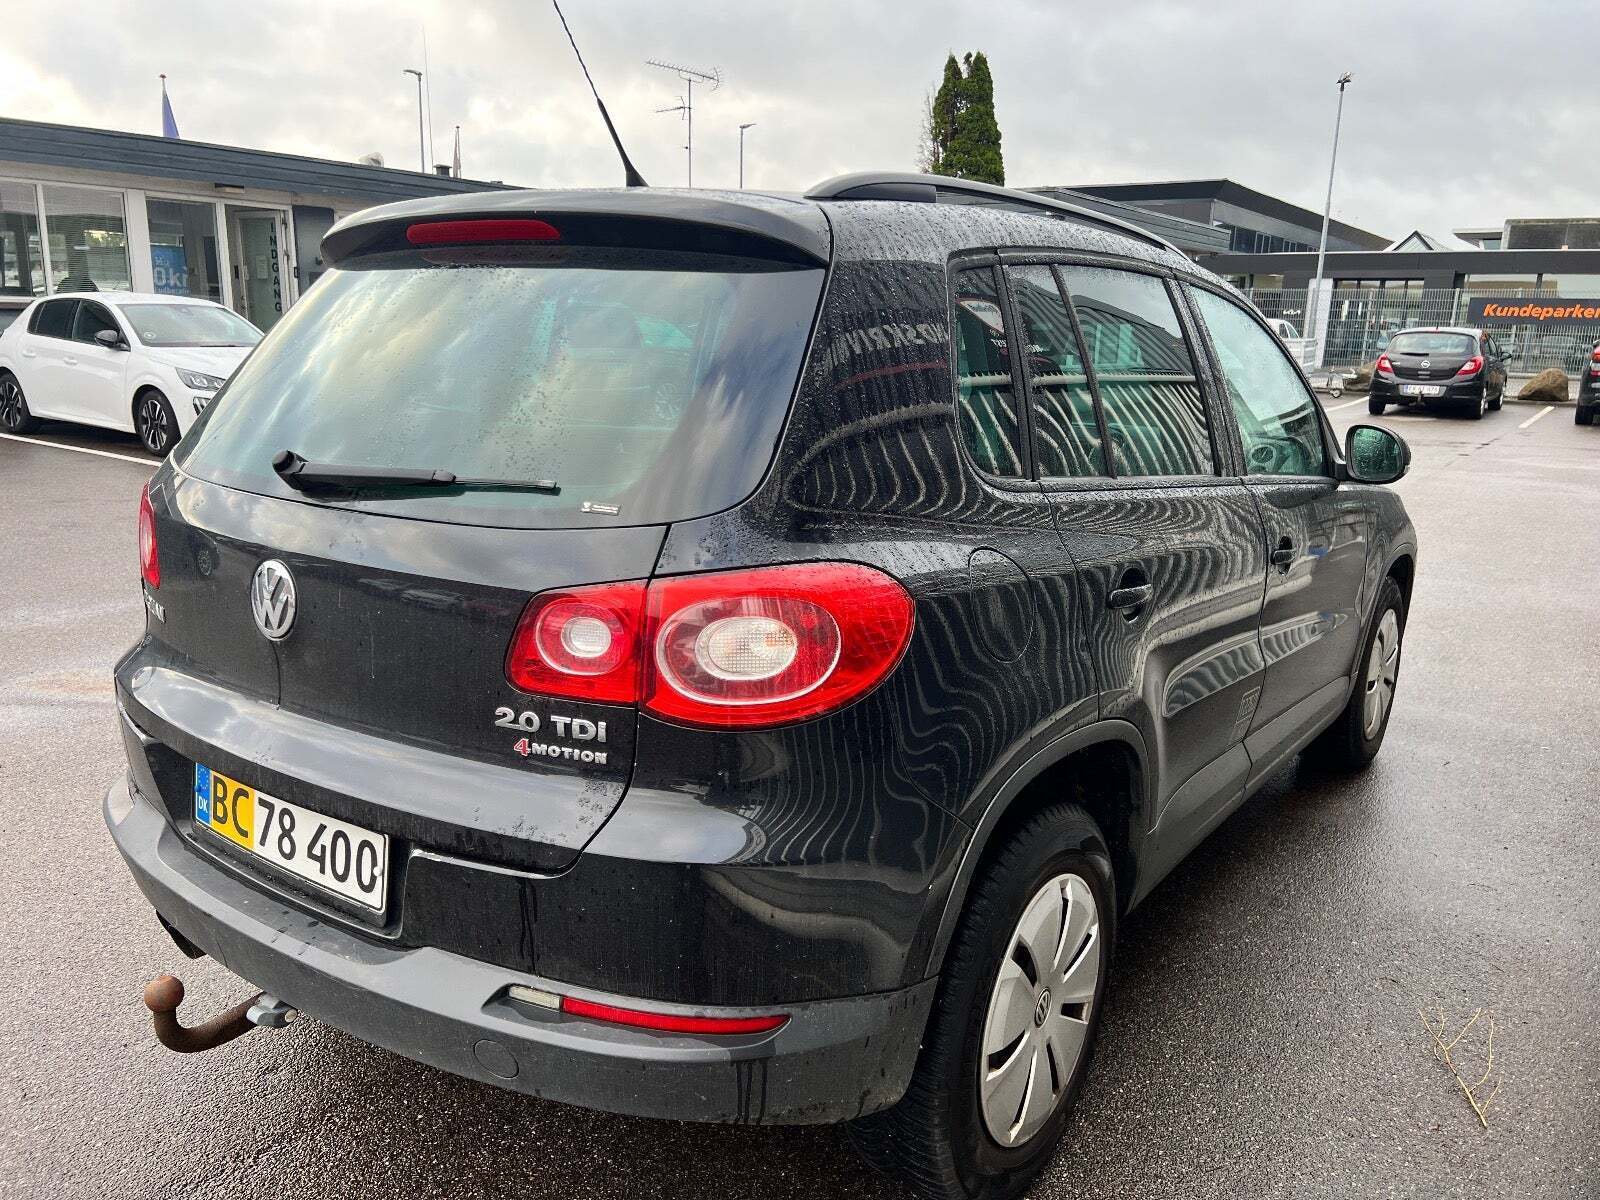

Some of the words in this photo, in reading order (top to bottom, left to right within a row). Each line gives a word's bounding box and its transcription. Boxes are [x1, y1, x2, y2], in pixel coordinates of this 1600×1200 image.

[269, 222, 282, 312] INDGANG
[513, 738, 608, 764] 4MOTION
[550, 715, 607, 742] TDI
[258, 797, 297, 861] 78
[306, 823, 379, 894] 400
